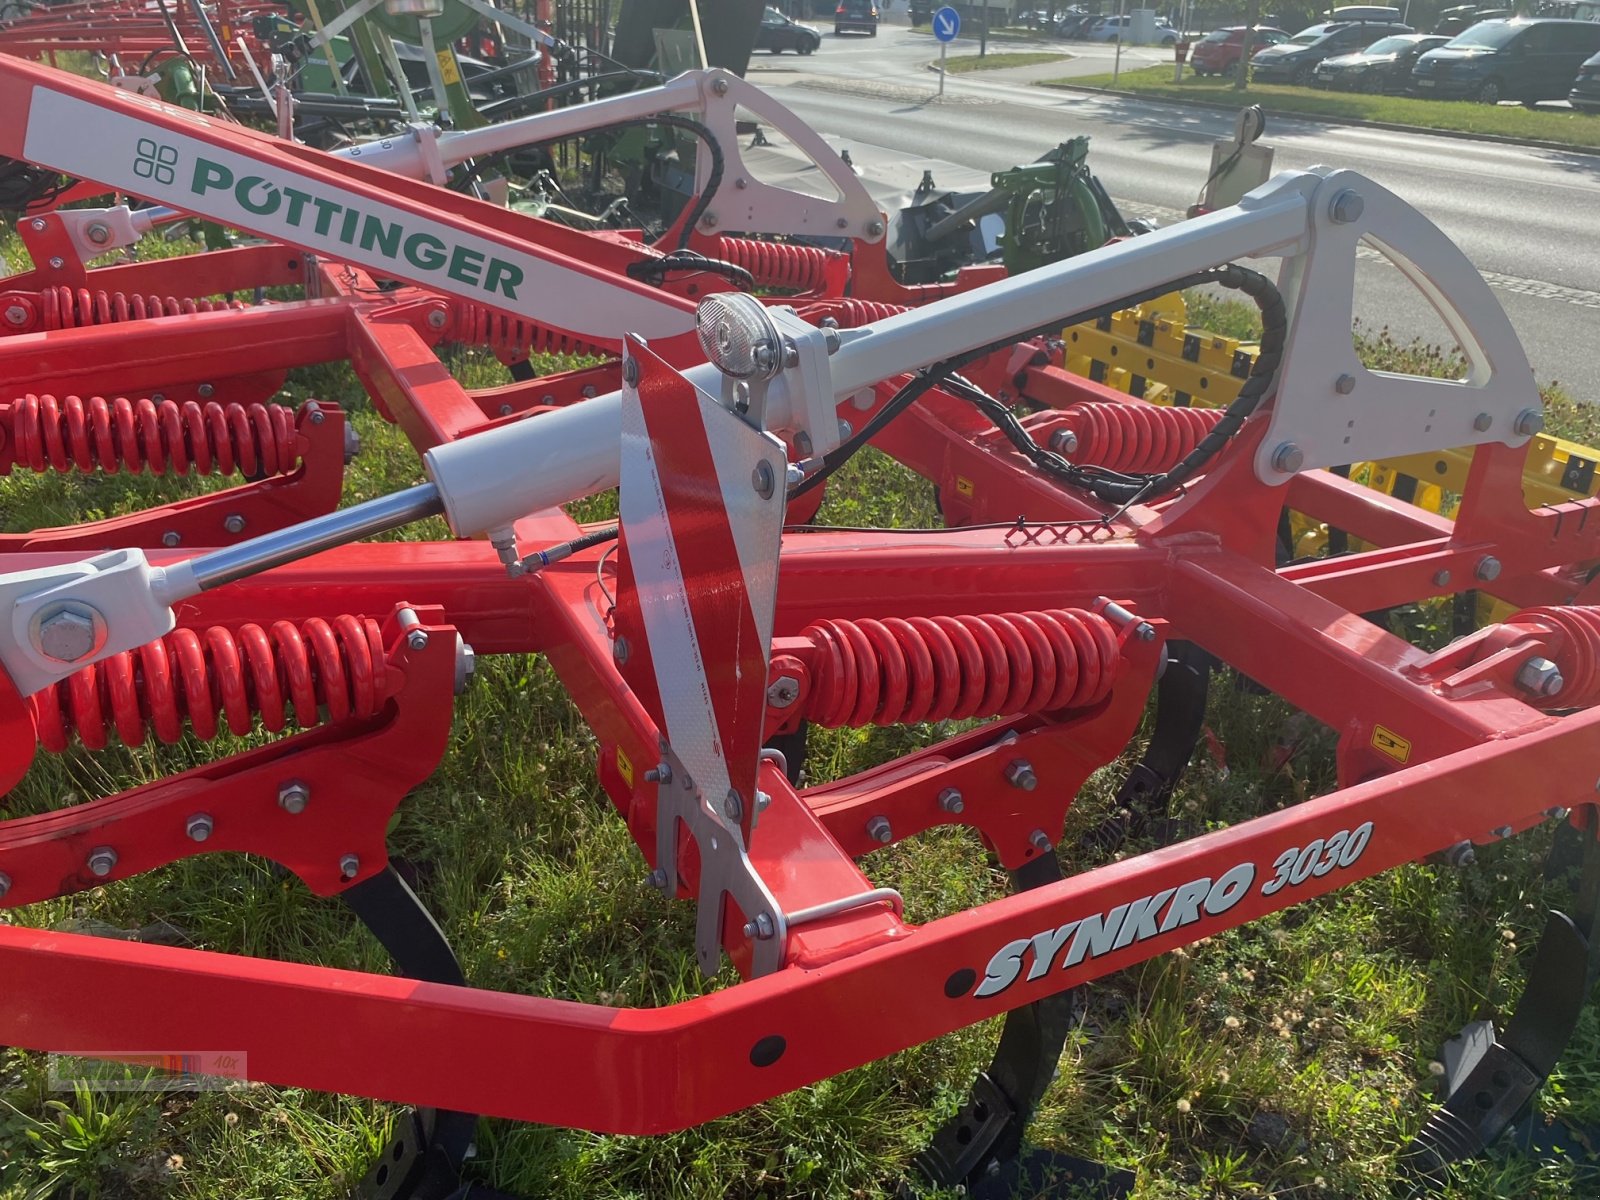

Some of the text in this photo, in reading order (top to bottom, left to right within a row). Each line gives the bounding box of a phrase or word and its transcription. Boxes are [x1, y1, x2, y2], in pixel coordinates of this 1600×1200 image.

[191, 157, 524, 300] PÖTTINGER
[973, 821, 1374, 997] SYNKRO 3030
